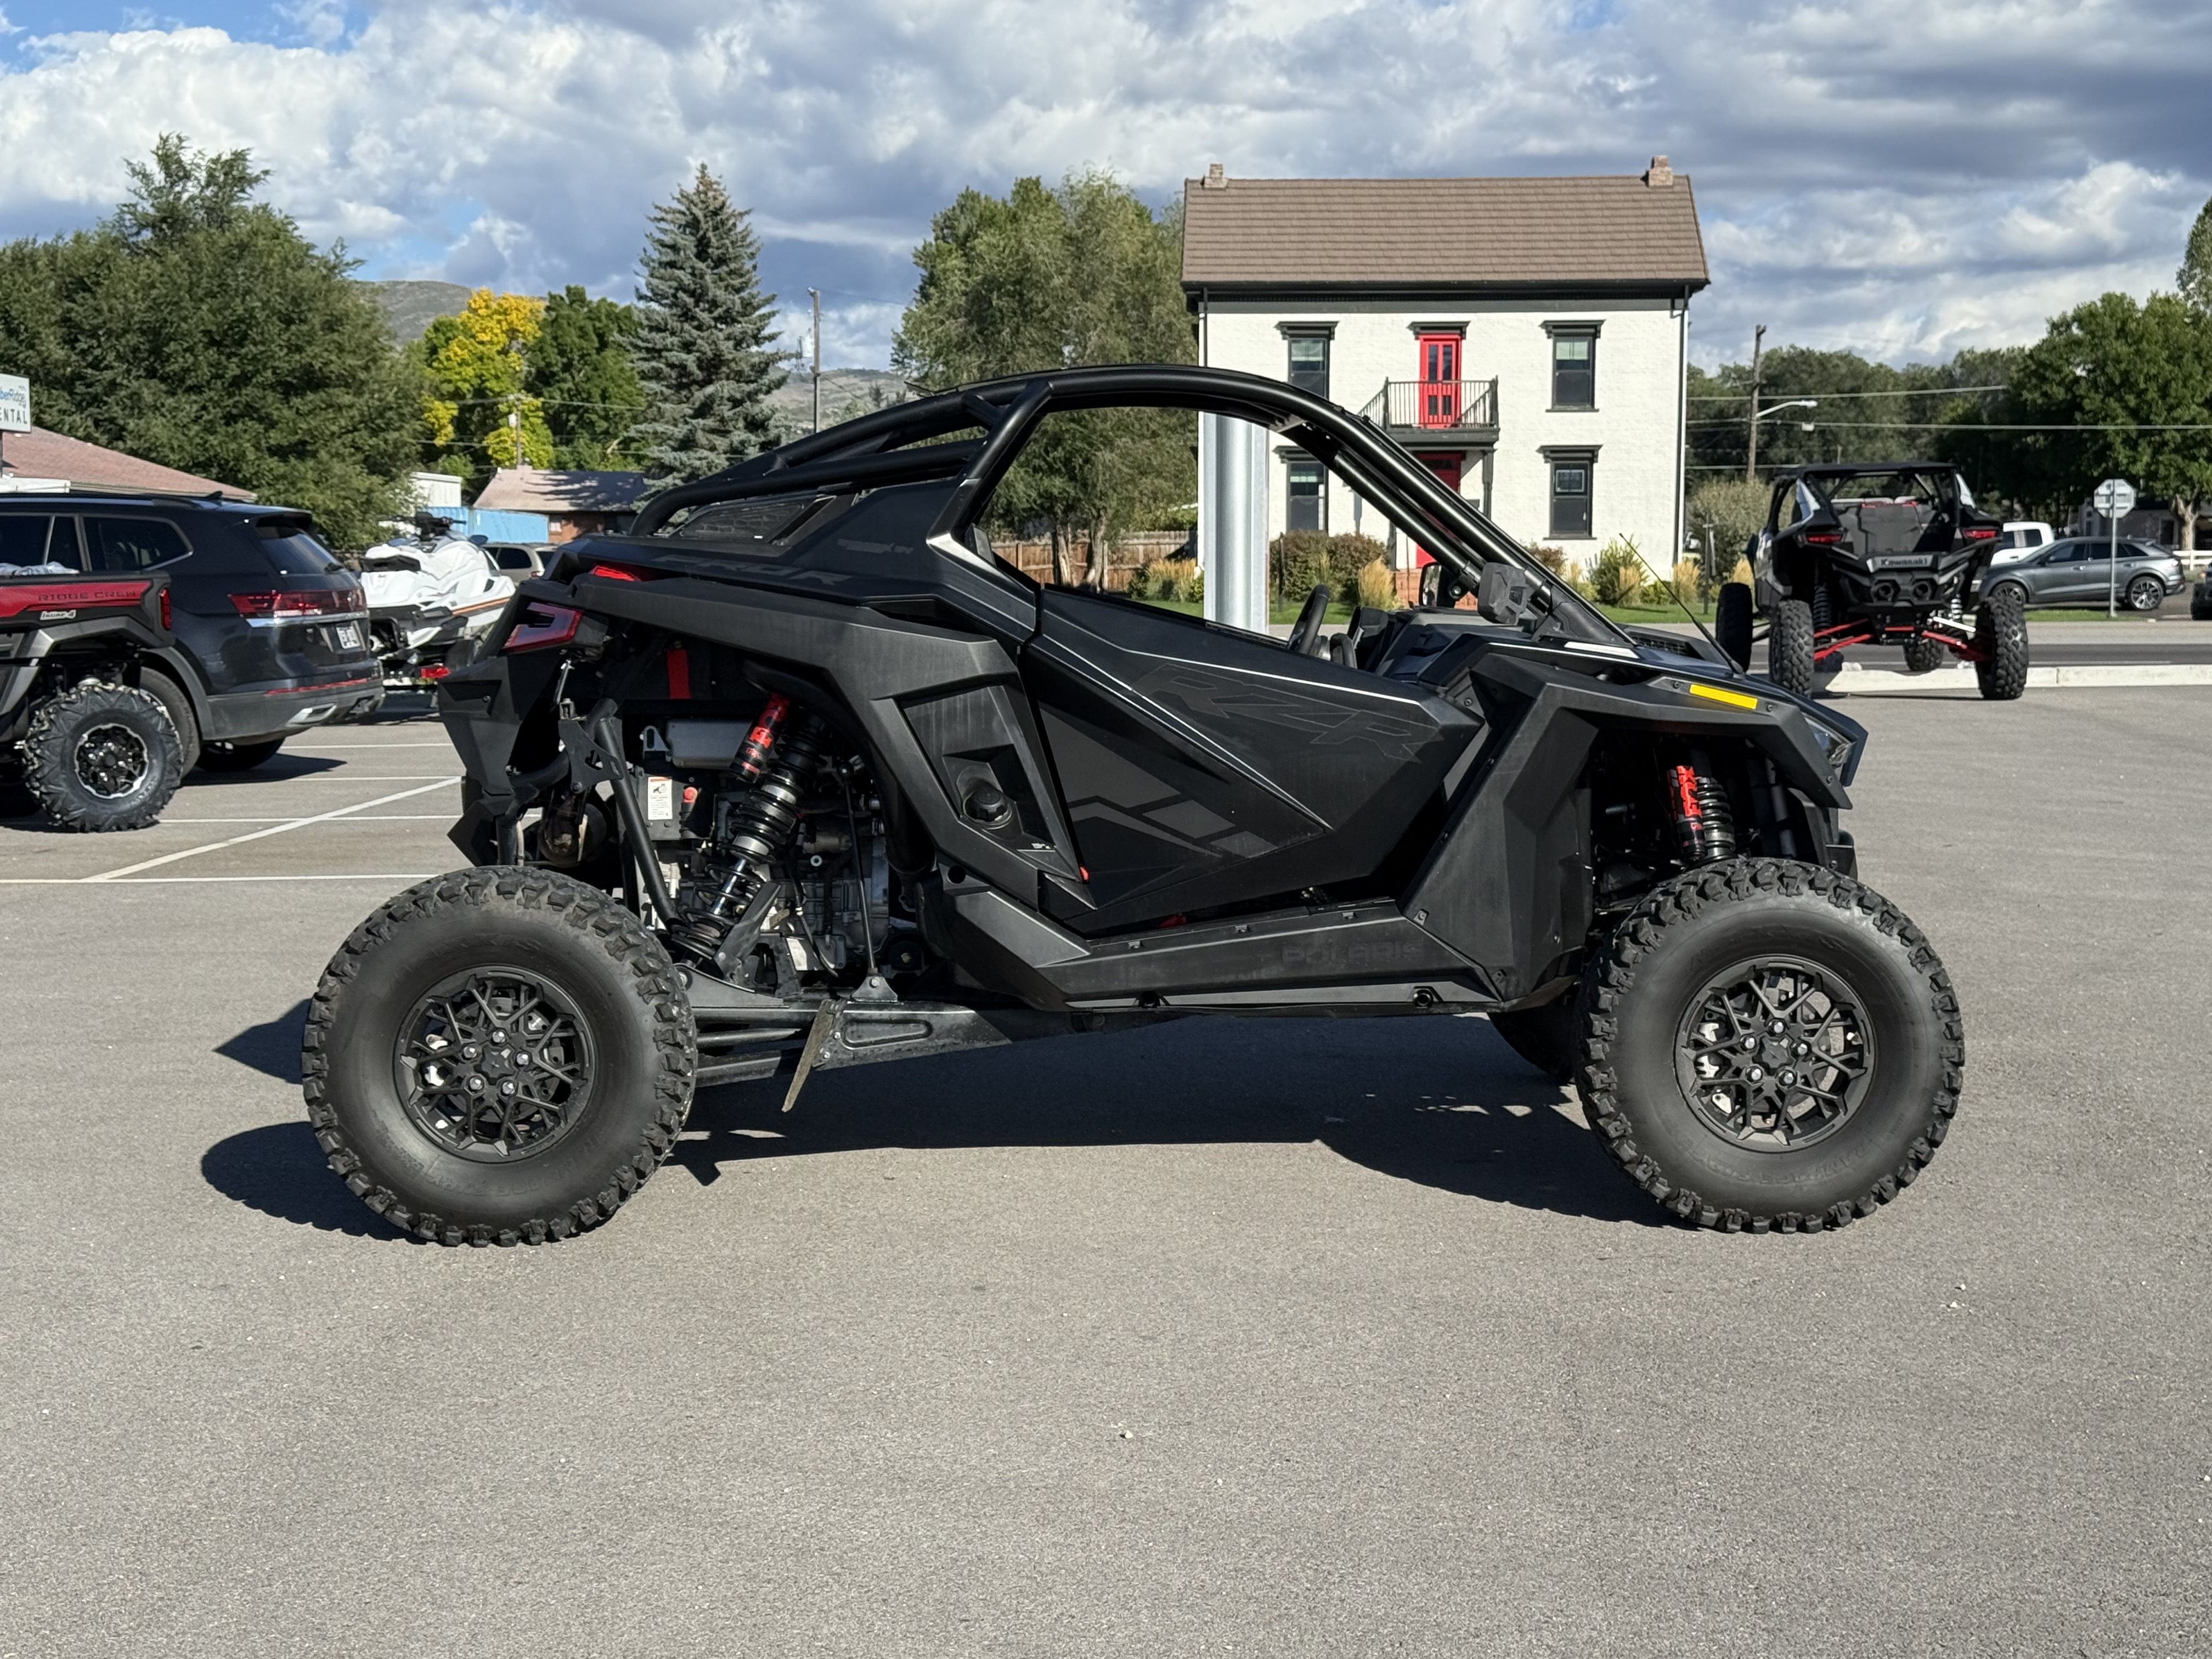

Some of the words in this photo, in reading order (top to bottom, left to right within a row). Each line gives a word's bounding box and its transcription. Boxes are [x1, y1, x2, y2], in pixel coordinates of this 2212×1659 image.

[1881, 557, 1927, 566] Kawasaki
[38, 592, 88, 602] RIDGE
[94, 590, 136, 599] CREW
[1132, 663, 1444, 763] RZR
[1282, 940, 1425, 967] POLARIS
